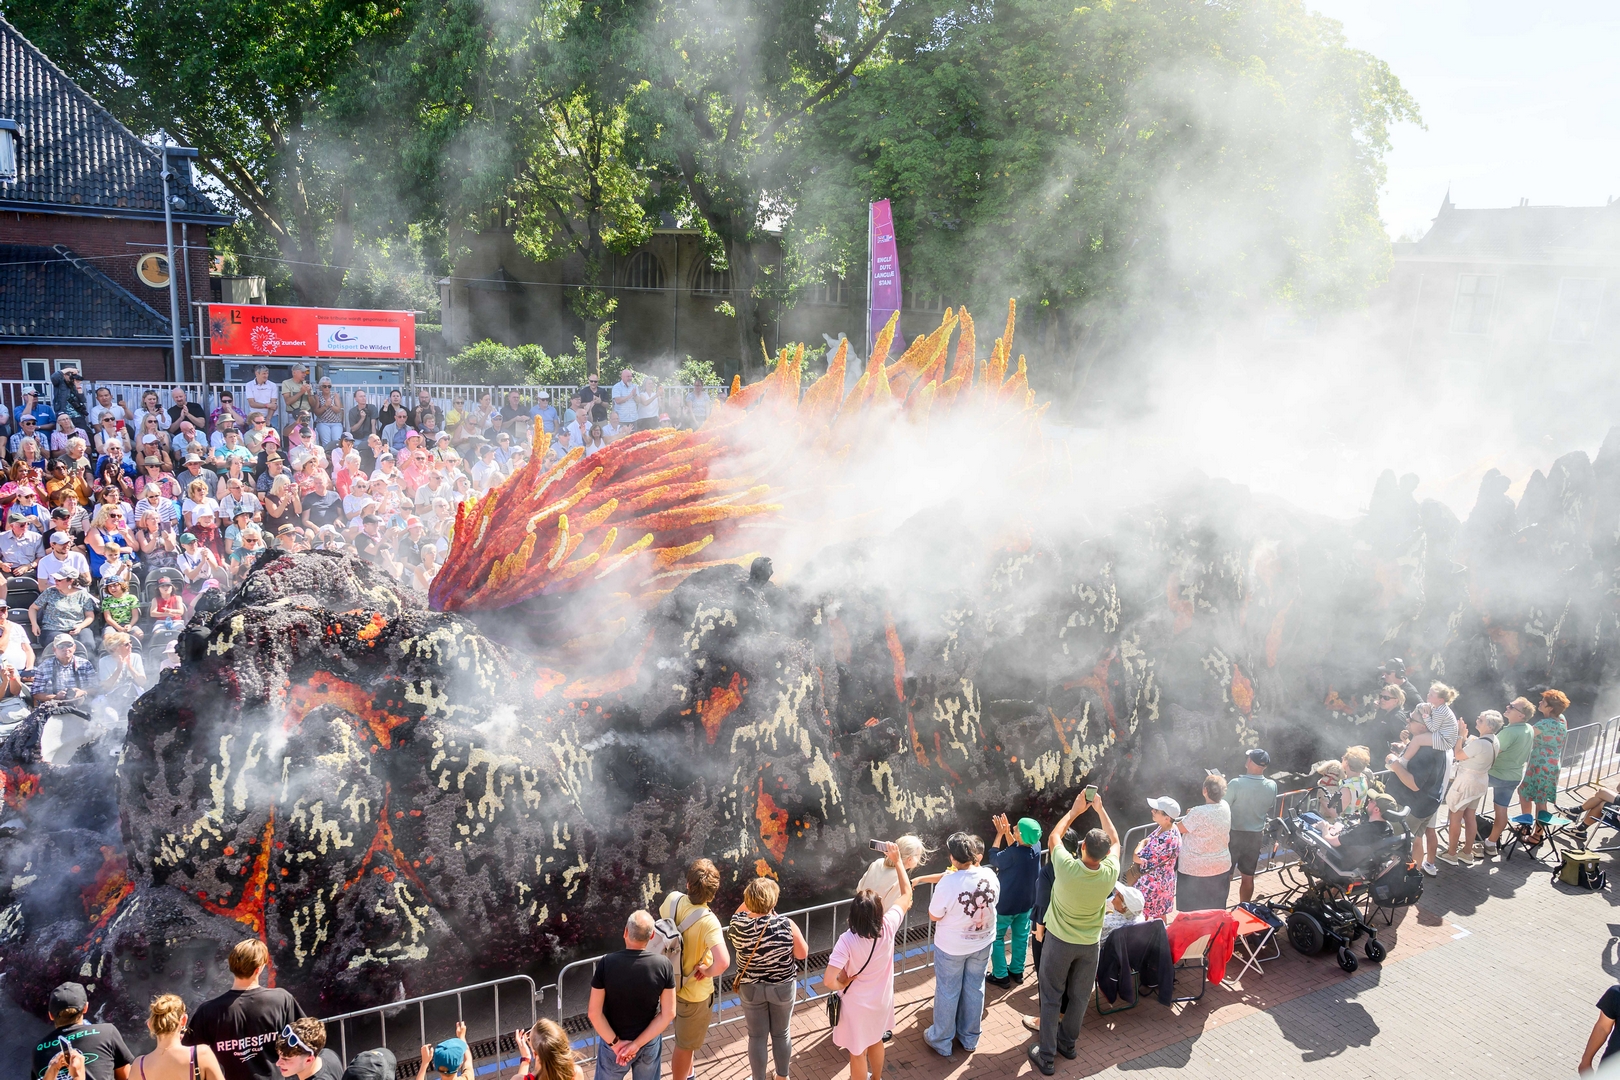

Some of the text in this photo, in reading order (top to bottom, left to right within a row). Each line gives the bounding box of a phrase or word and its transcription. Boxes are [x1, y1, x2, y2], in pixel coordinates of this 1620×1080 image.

[251, 315, 288, 324] tribune
[327, 343, 359, 351] Optisport
[36, 1028, 101, 1051] QUORELL
[216, 1031, 279, 1052] REPRESENT
